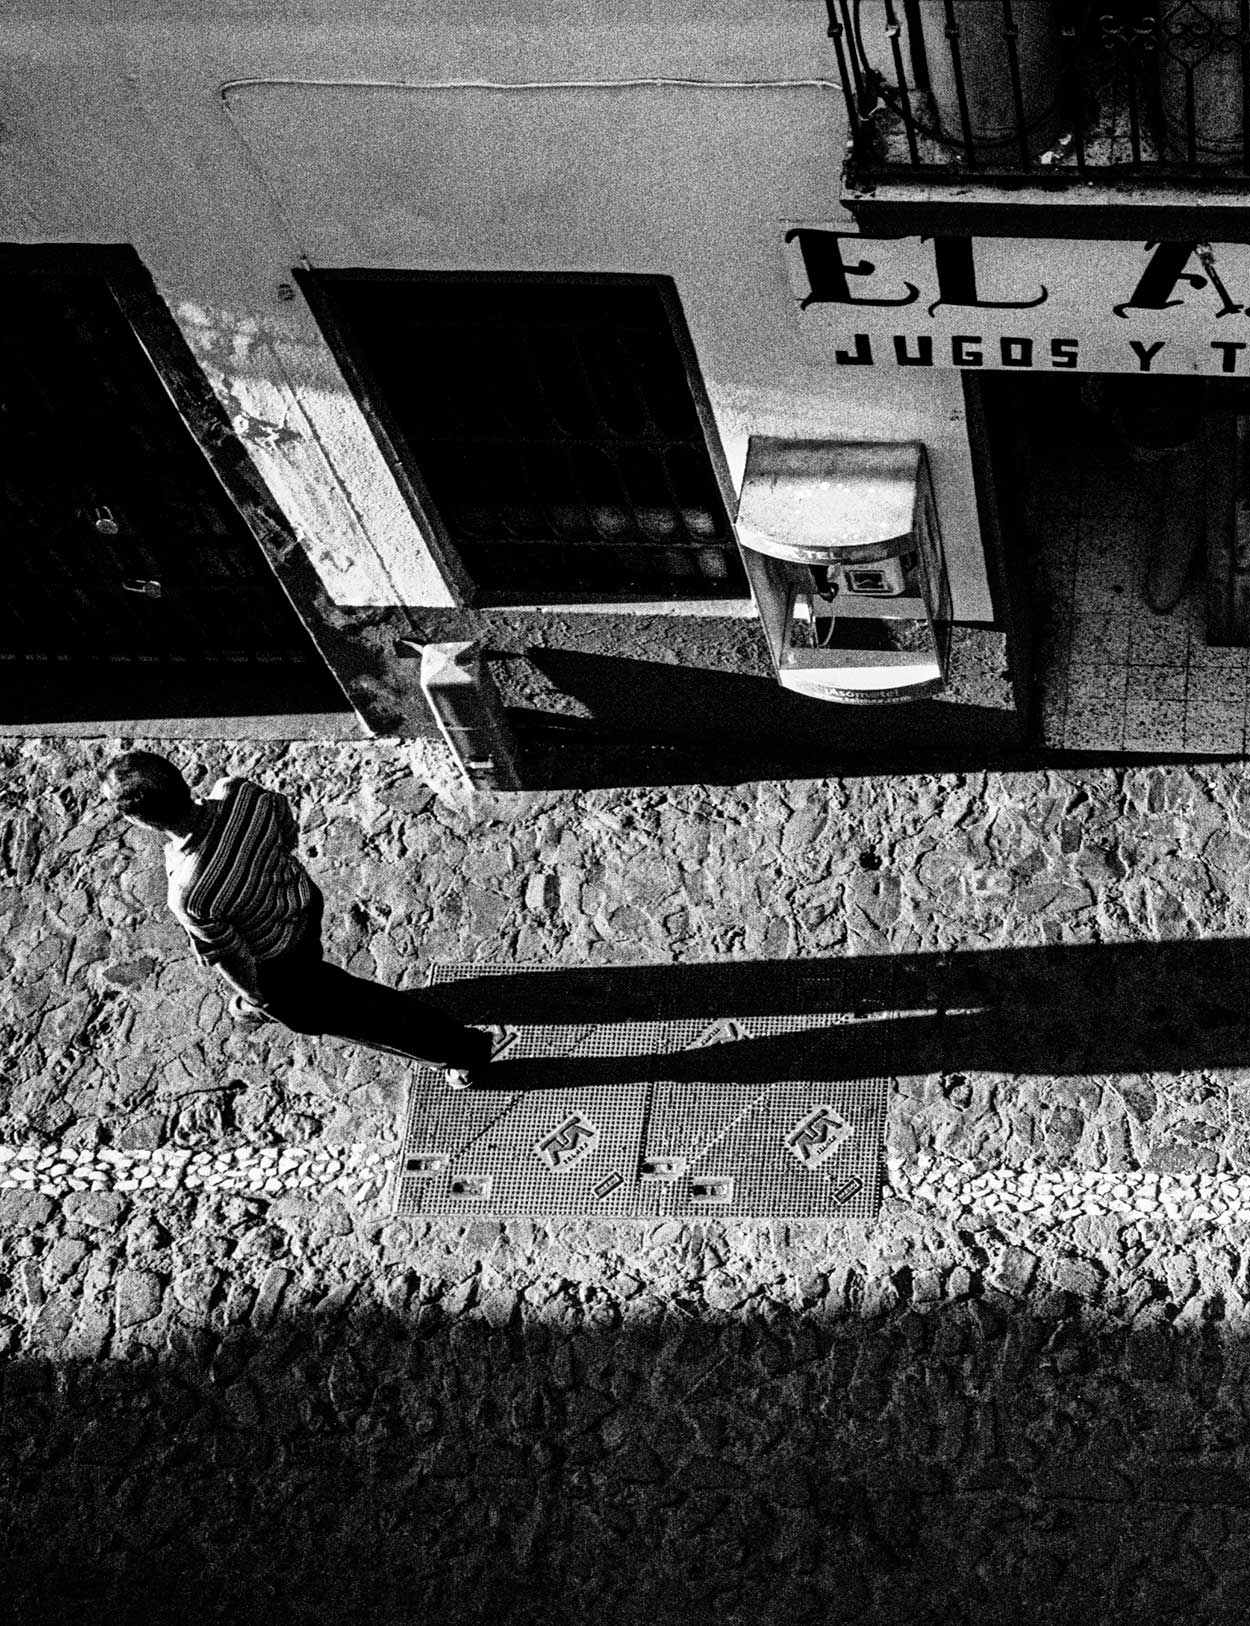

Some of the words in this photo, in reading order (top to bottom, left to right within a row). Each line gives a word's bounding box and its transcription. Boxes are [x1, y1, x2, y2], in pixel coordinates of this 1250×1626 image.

[785, 228, 1049, 317] EL
[835, 334, 1079, 367] JUGOS
[1129, 340, 1166, 371] Y
